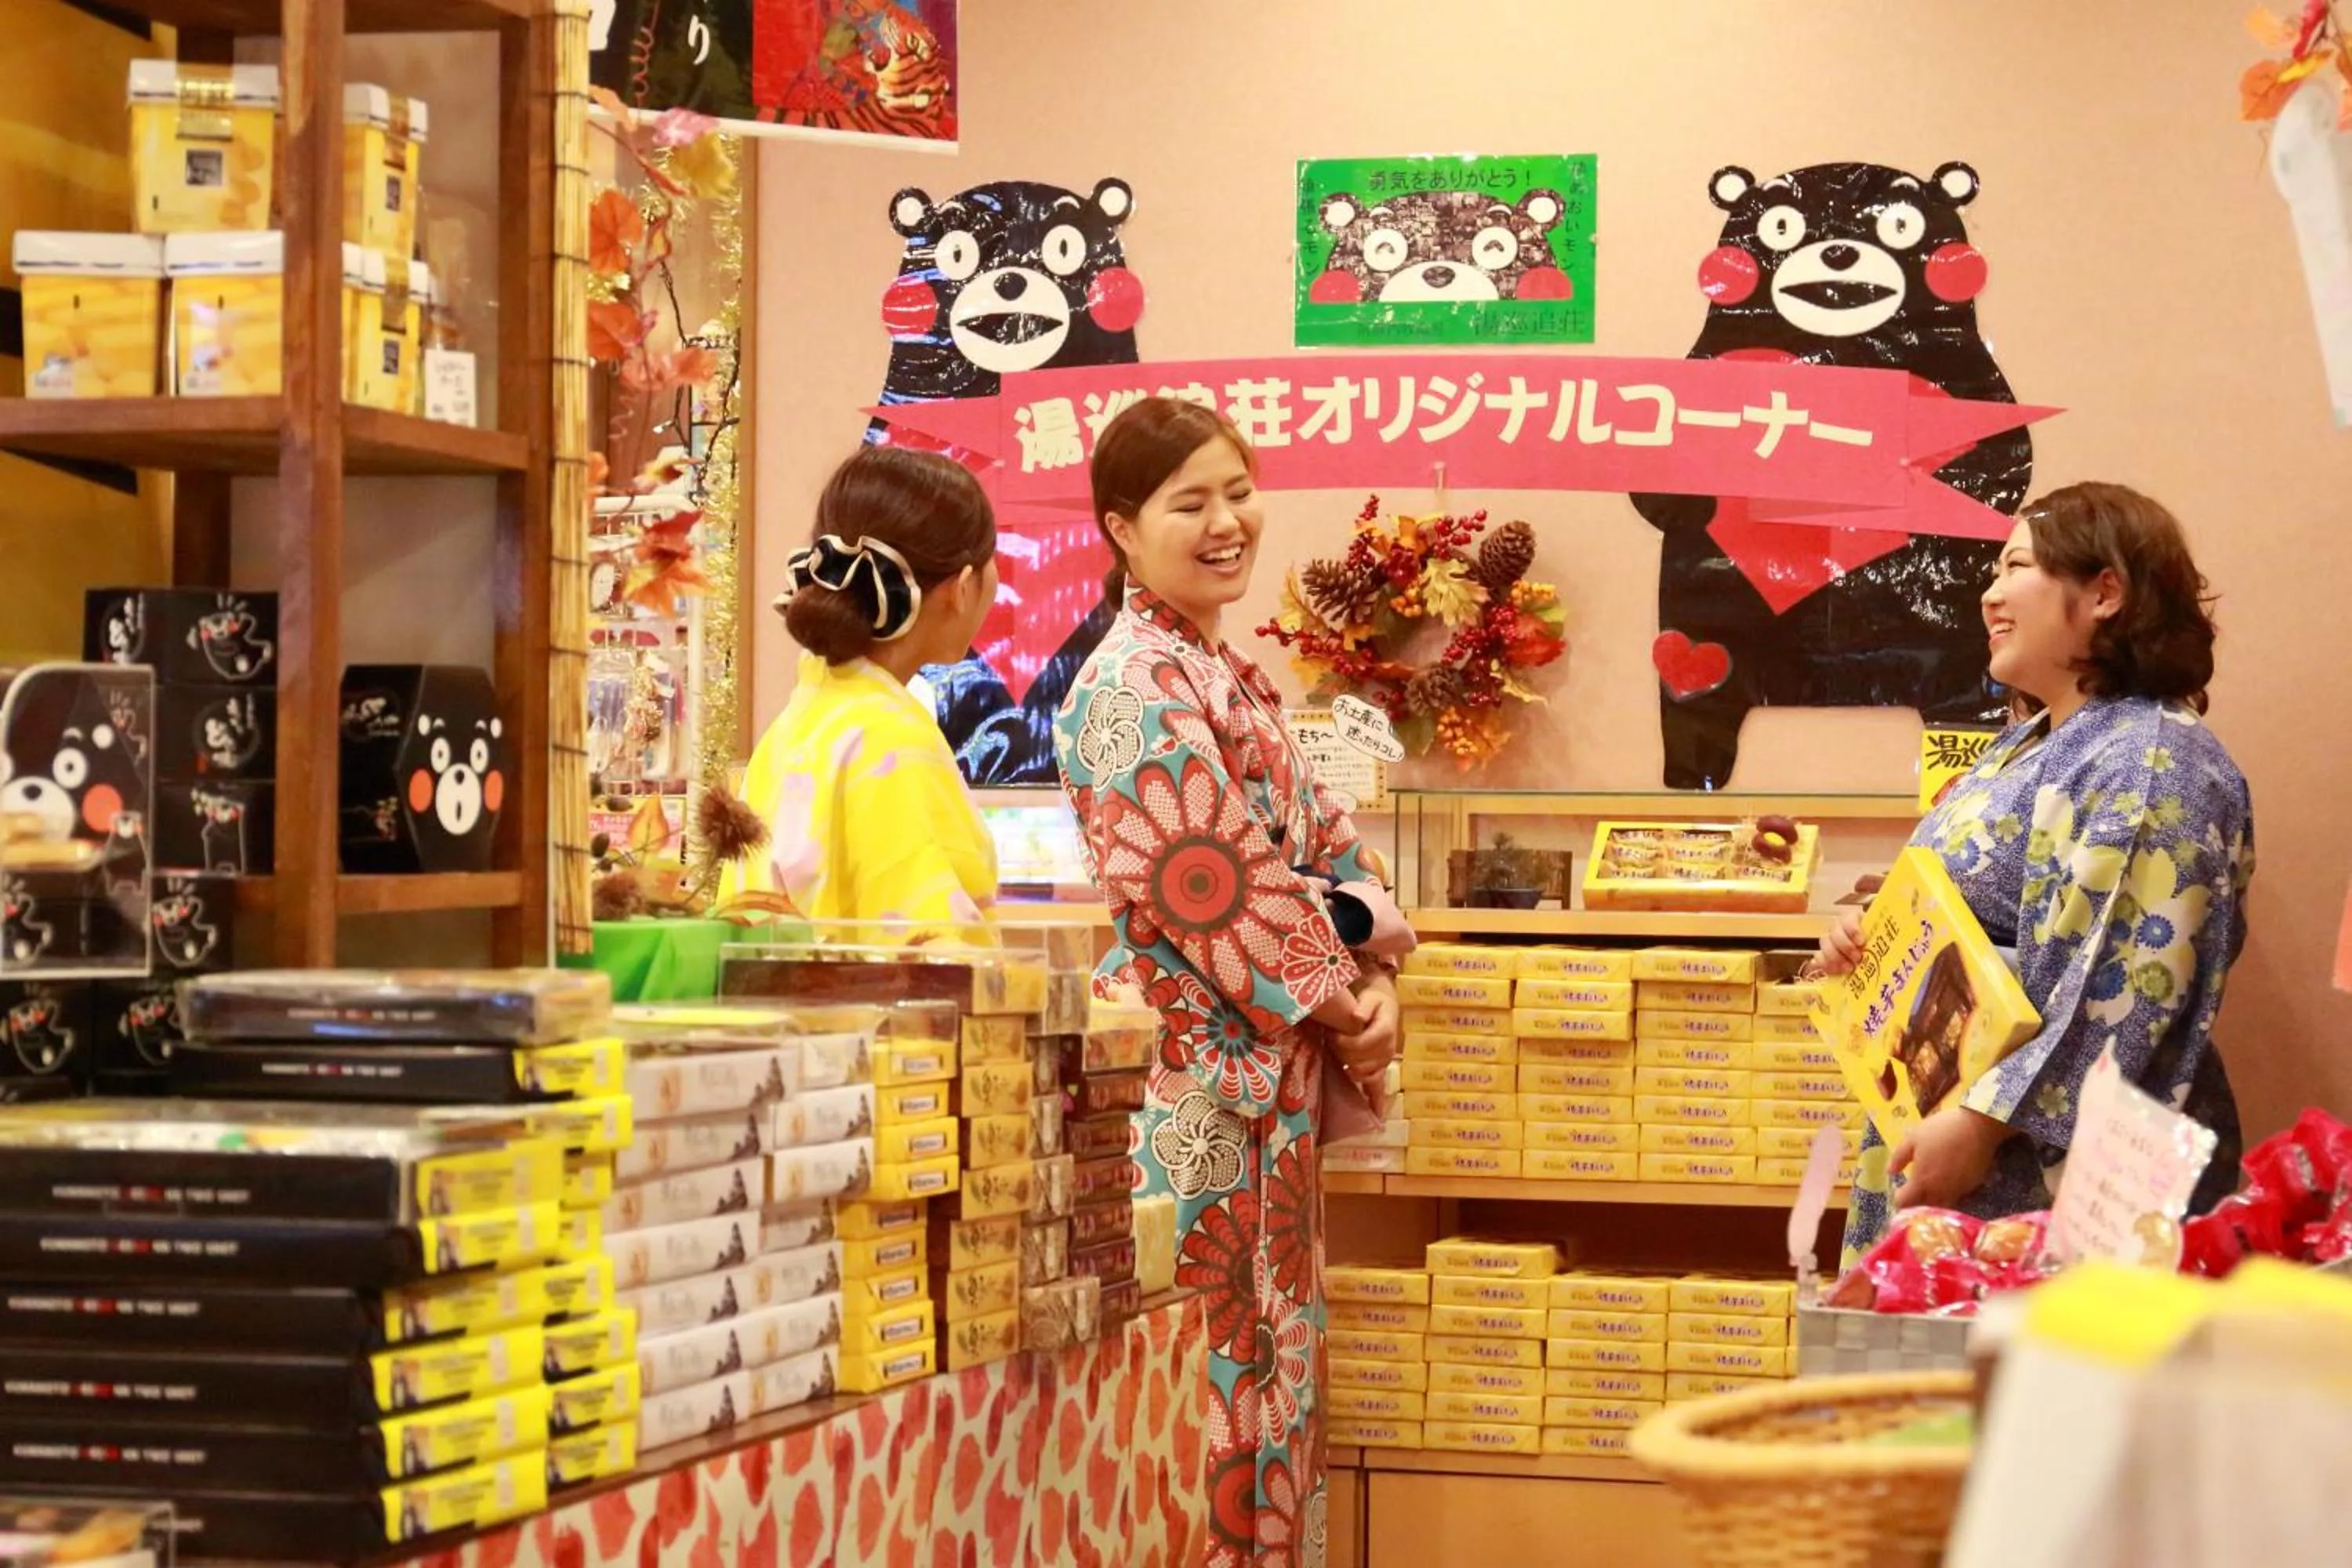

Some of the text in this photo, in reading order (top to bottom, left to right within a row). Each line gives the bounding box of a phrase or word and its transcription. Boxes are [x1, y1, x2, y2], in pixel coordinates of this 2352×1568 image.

[1014, 372, 1873, 474] 湯荘オリジナルコーナー
